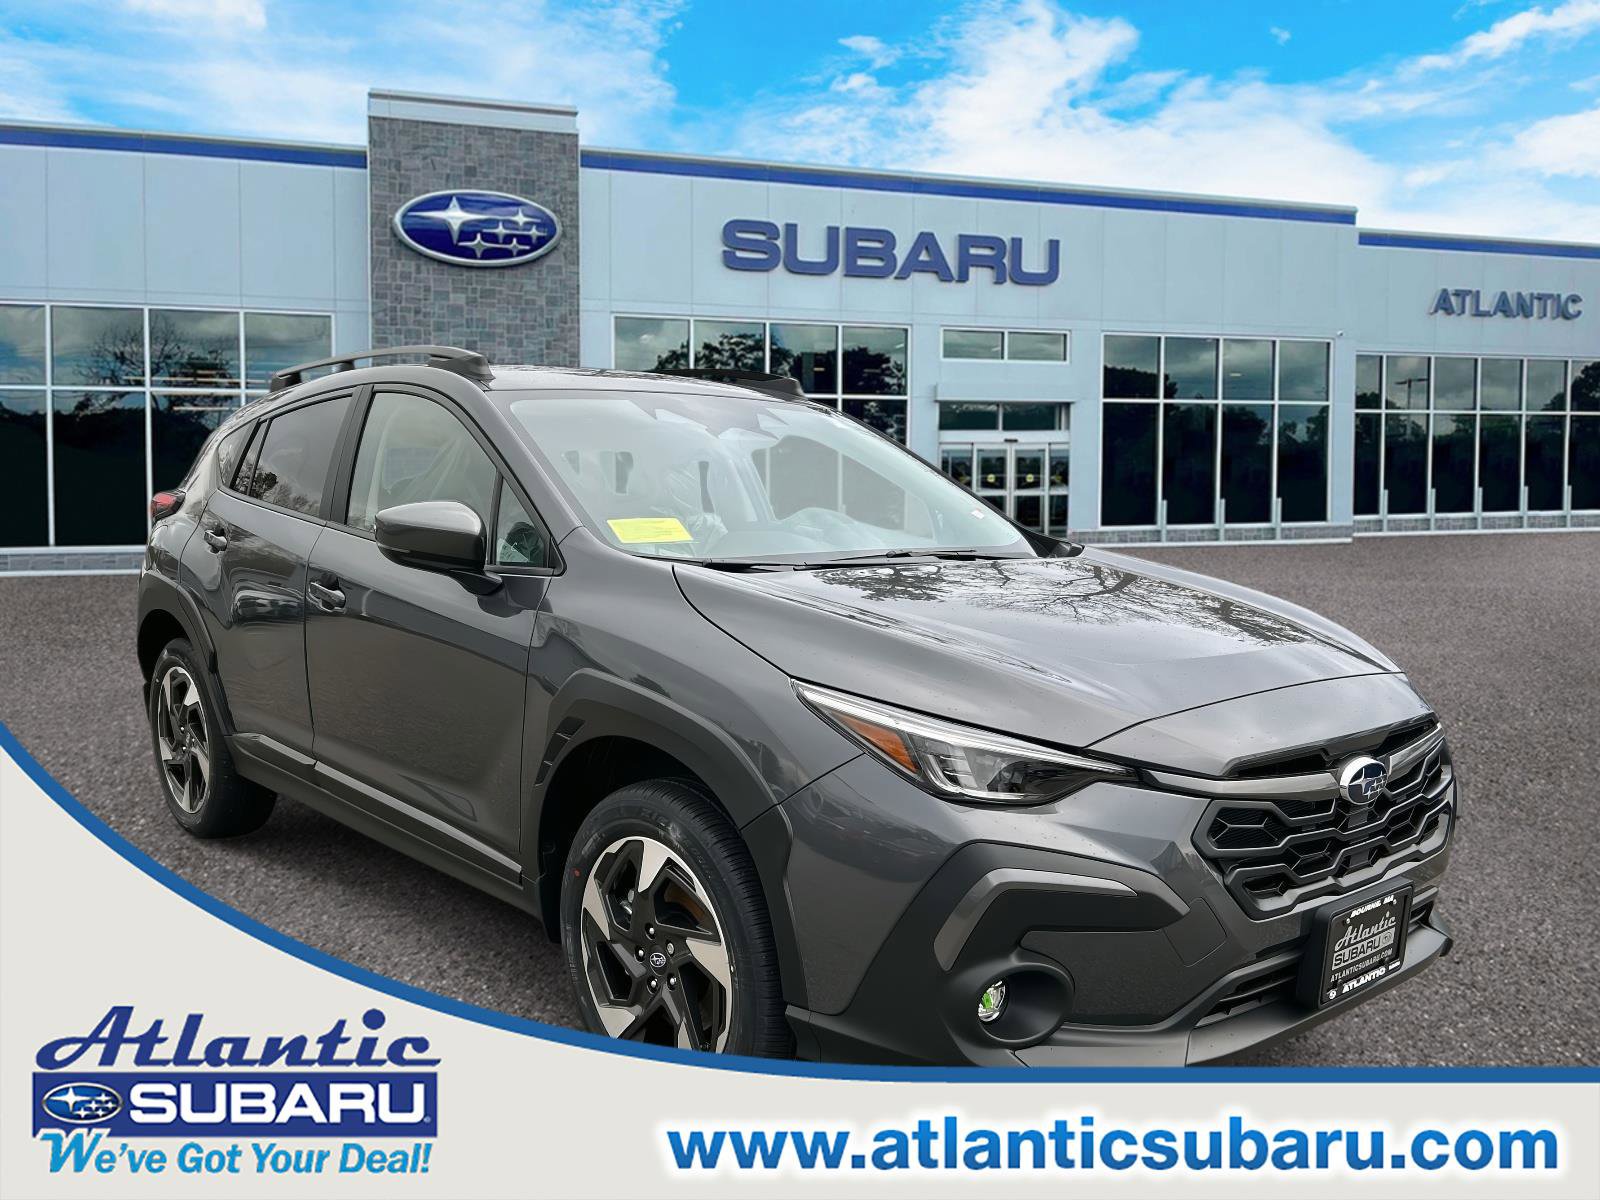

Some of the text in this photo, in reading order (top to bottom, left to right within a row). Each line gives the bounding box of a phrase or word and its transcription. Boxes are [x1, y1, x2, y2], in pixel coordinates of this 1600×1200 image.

[721, 218, 1061, 287] SUBARU
[1430, 287, 1583, 320] ATLANTIC
[1334, 911, 1397, 951] Atlantic
[1330, 947, 1393, 983] ATLANTICSUBARU.COM
[1333, 935, 1383, 967] SUBARU
